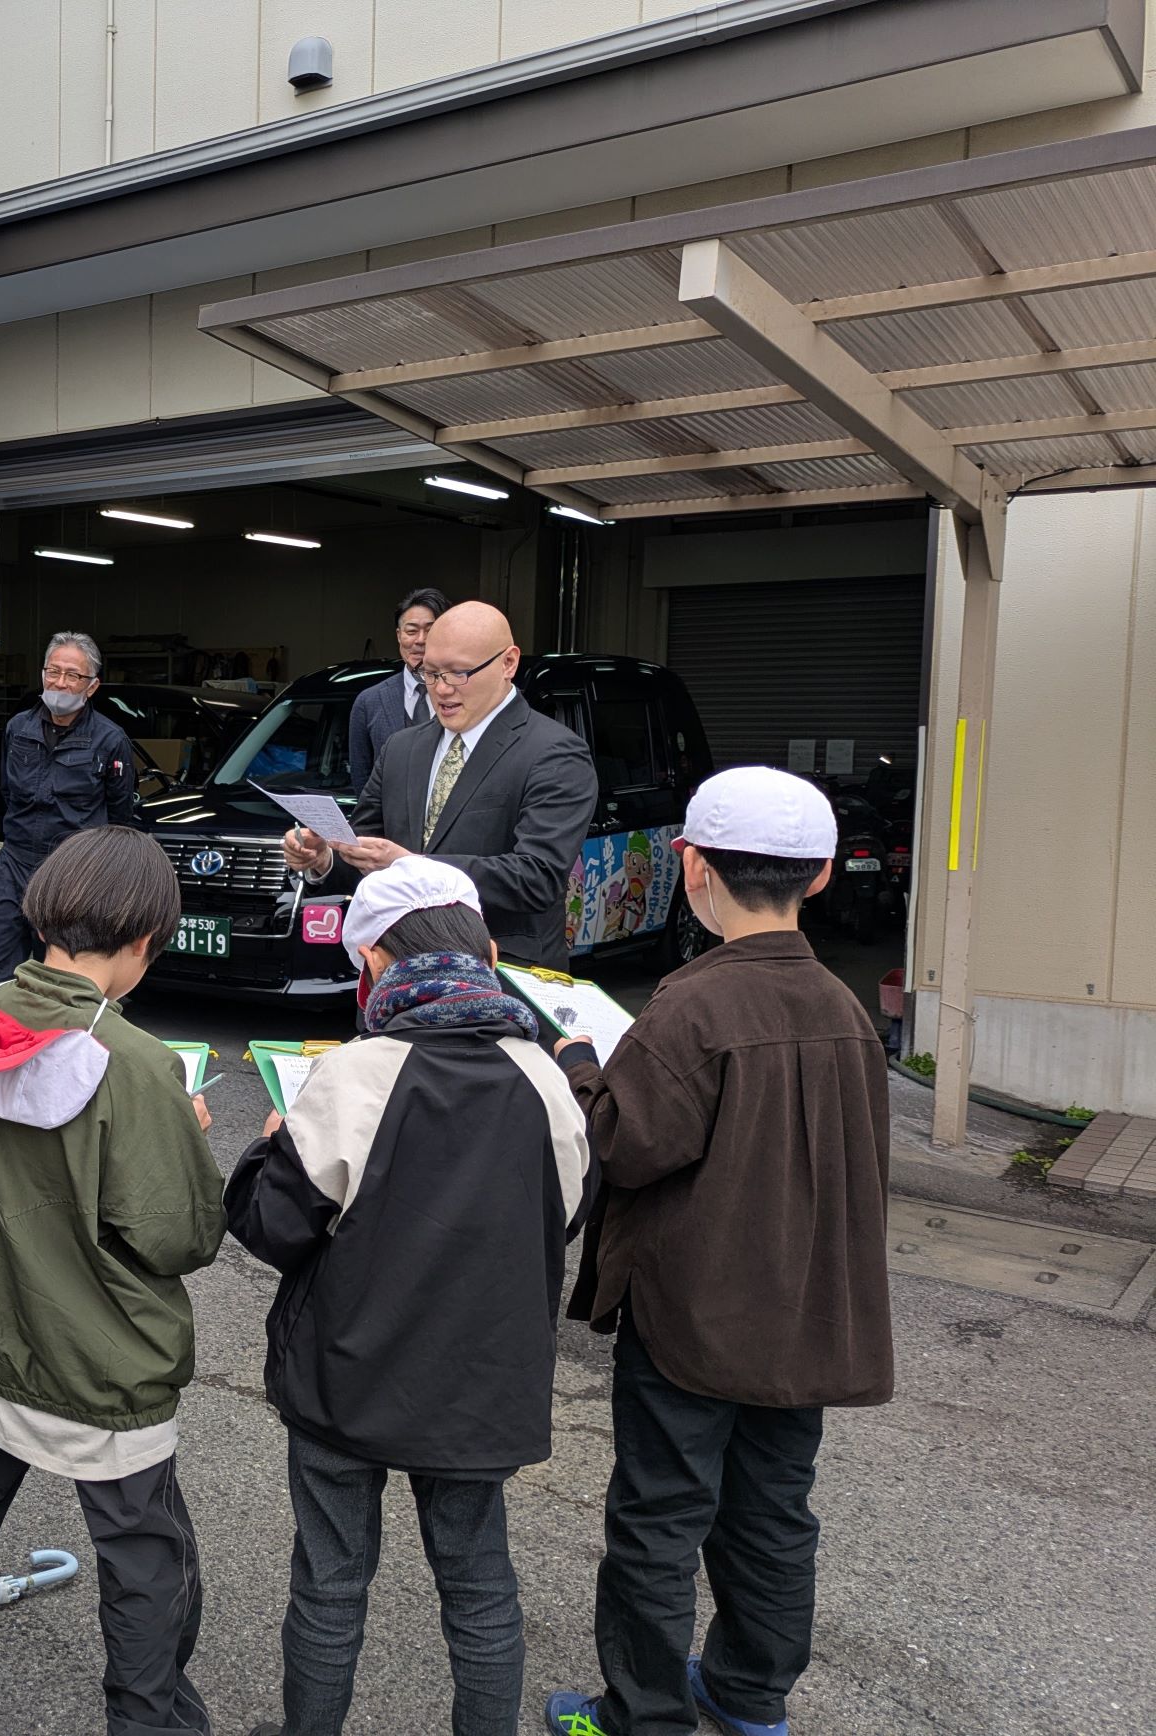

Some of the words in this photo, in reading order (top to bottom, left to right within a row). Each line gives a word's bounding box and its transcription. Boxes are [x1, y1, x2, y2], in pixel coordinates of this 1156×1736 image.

[582, 857, 600, 941] ヘルメット
[179, 917, 197, 929] 多摩
[198, 919, 215, 931] 530
[177, 930, 226, 955] 81-19
